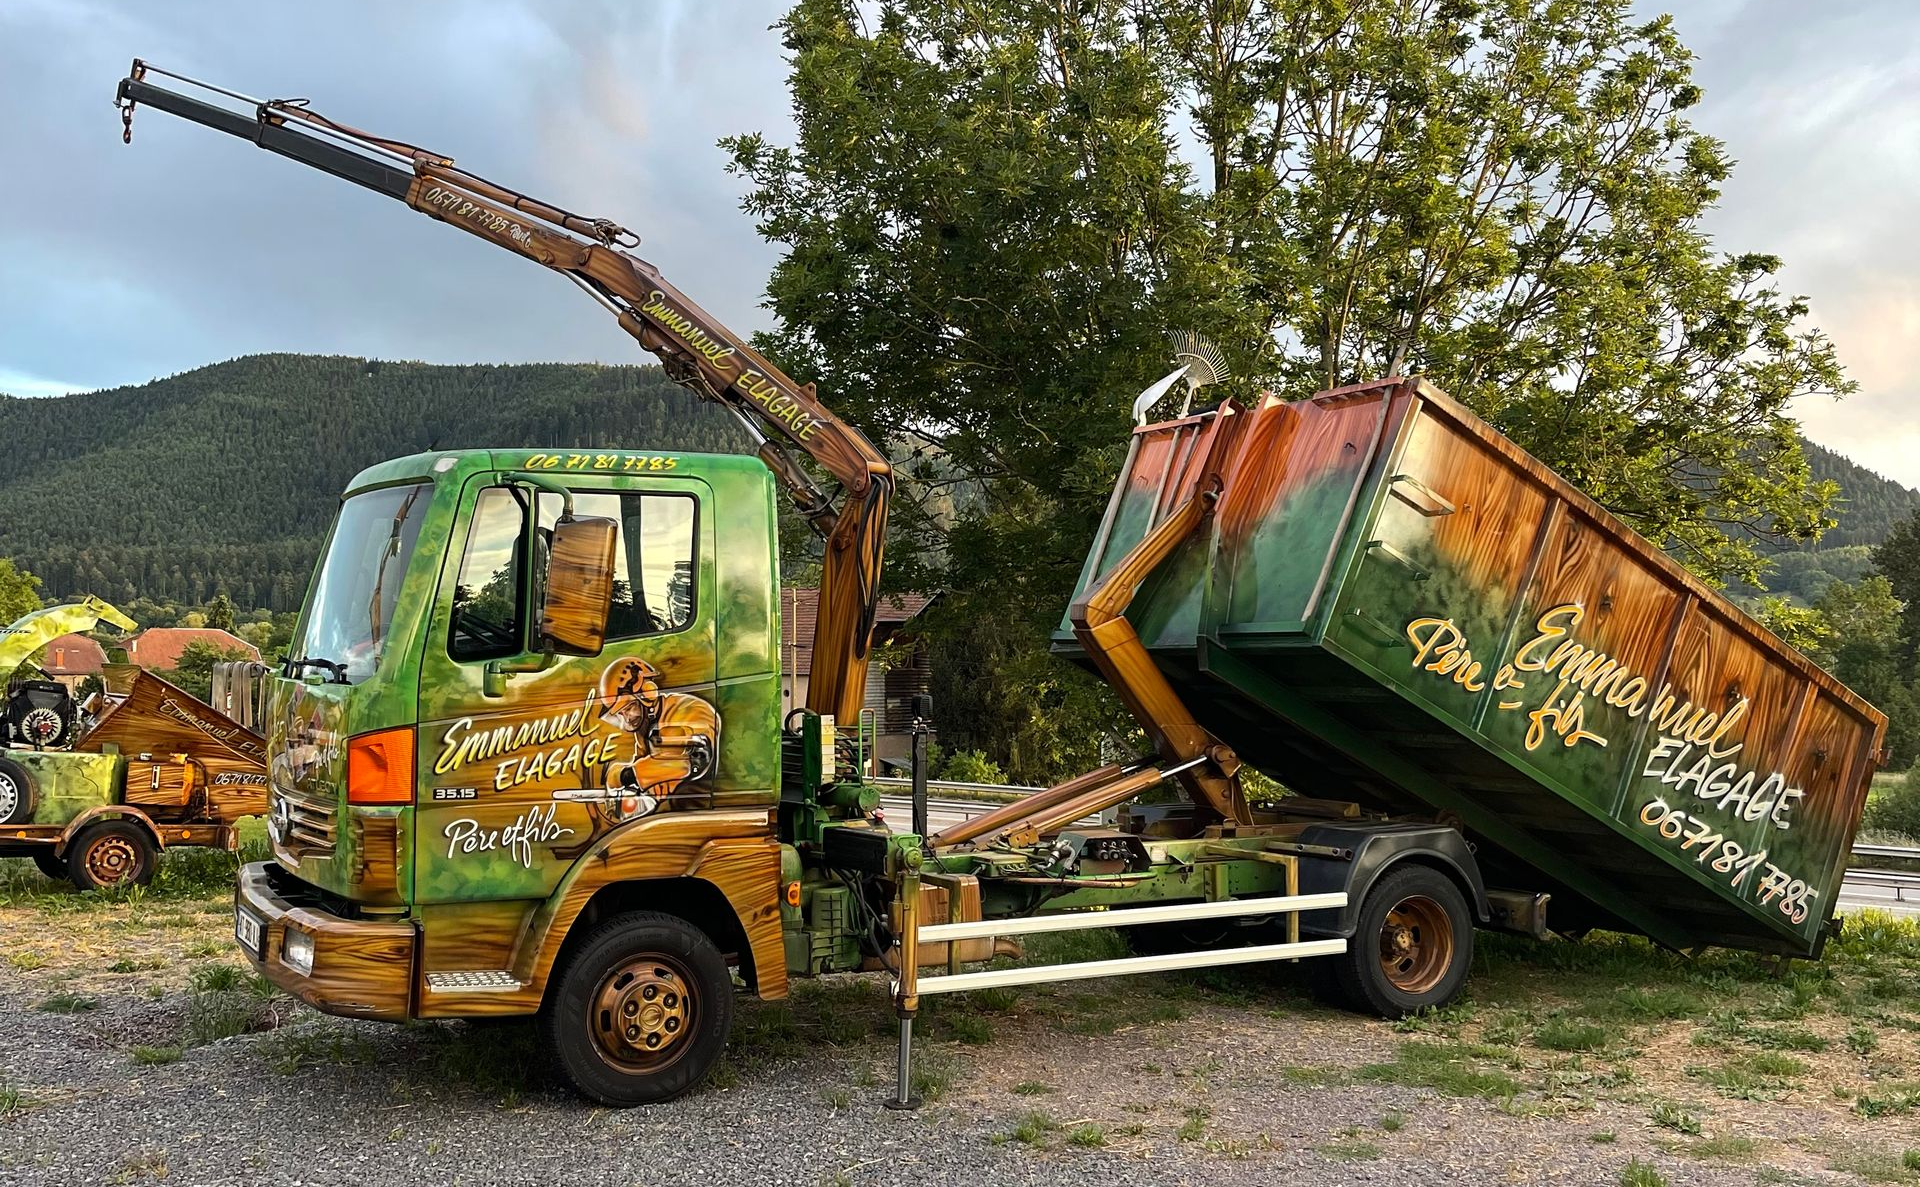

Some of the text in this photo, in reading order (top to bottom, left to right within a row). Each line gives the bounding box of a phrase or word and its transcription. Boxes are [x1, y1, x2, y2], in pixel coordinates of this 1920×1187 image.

[642, 290, 822, 441] Emmanuel ELAGAGE
[524, 453, 562, 469] 06
[1407, 617, 1484, 691] Père
[1525, 679, 1608, 751] fils
[1514, 603, 1747, 758] Emmanuel
[159, 698, 267, 760] Emmanuel ELA
[433, 688, 600, 775] Emmanuel
[495, 733, 621, 791] ELAGAGE
[435, 788, 476, 799] 35.15
[1642, 736, 1804, 829] ELAGAGE
[444, 819, 498, 859] Père
